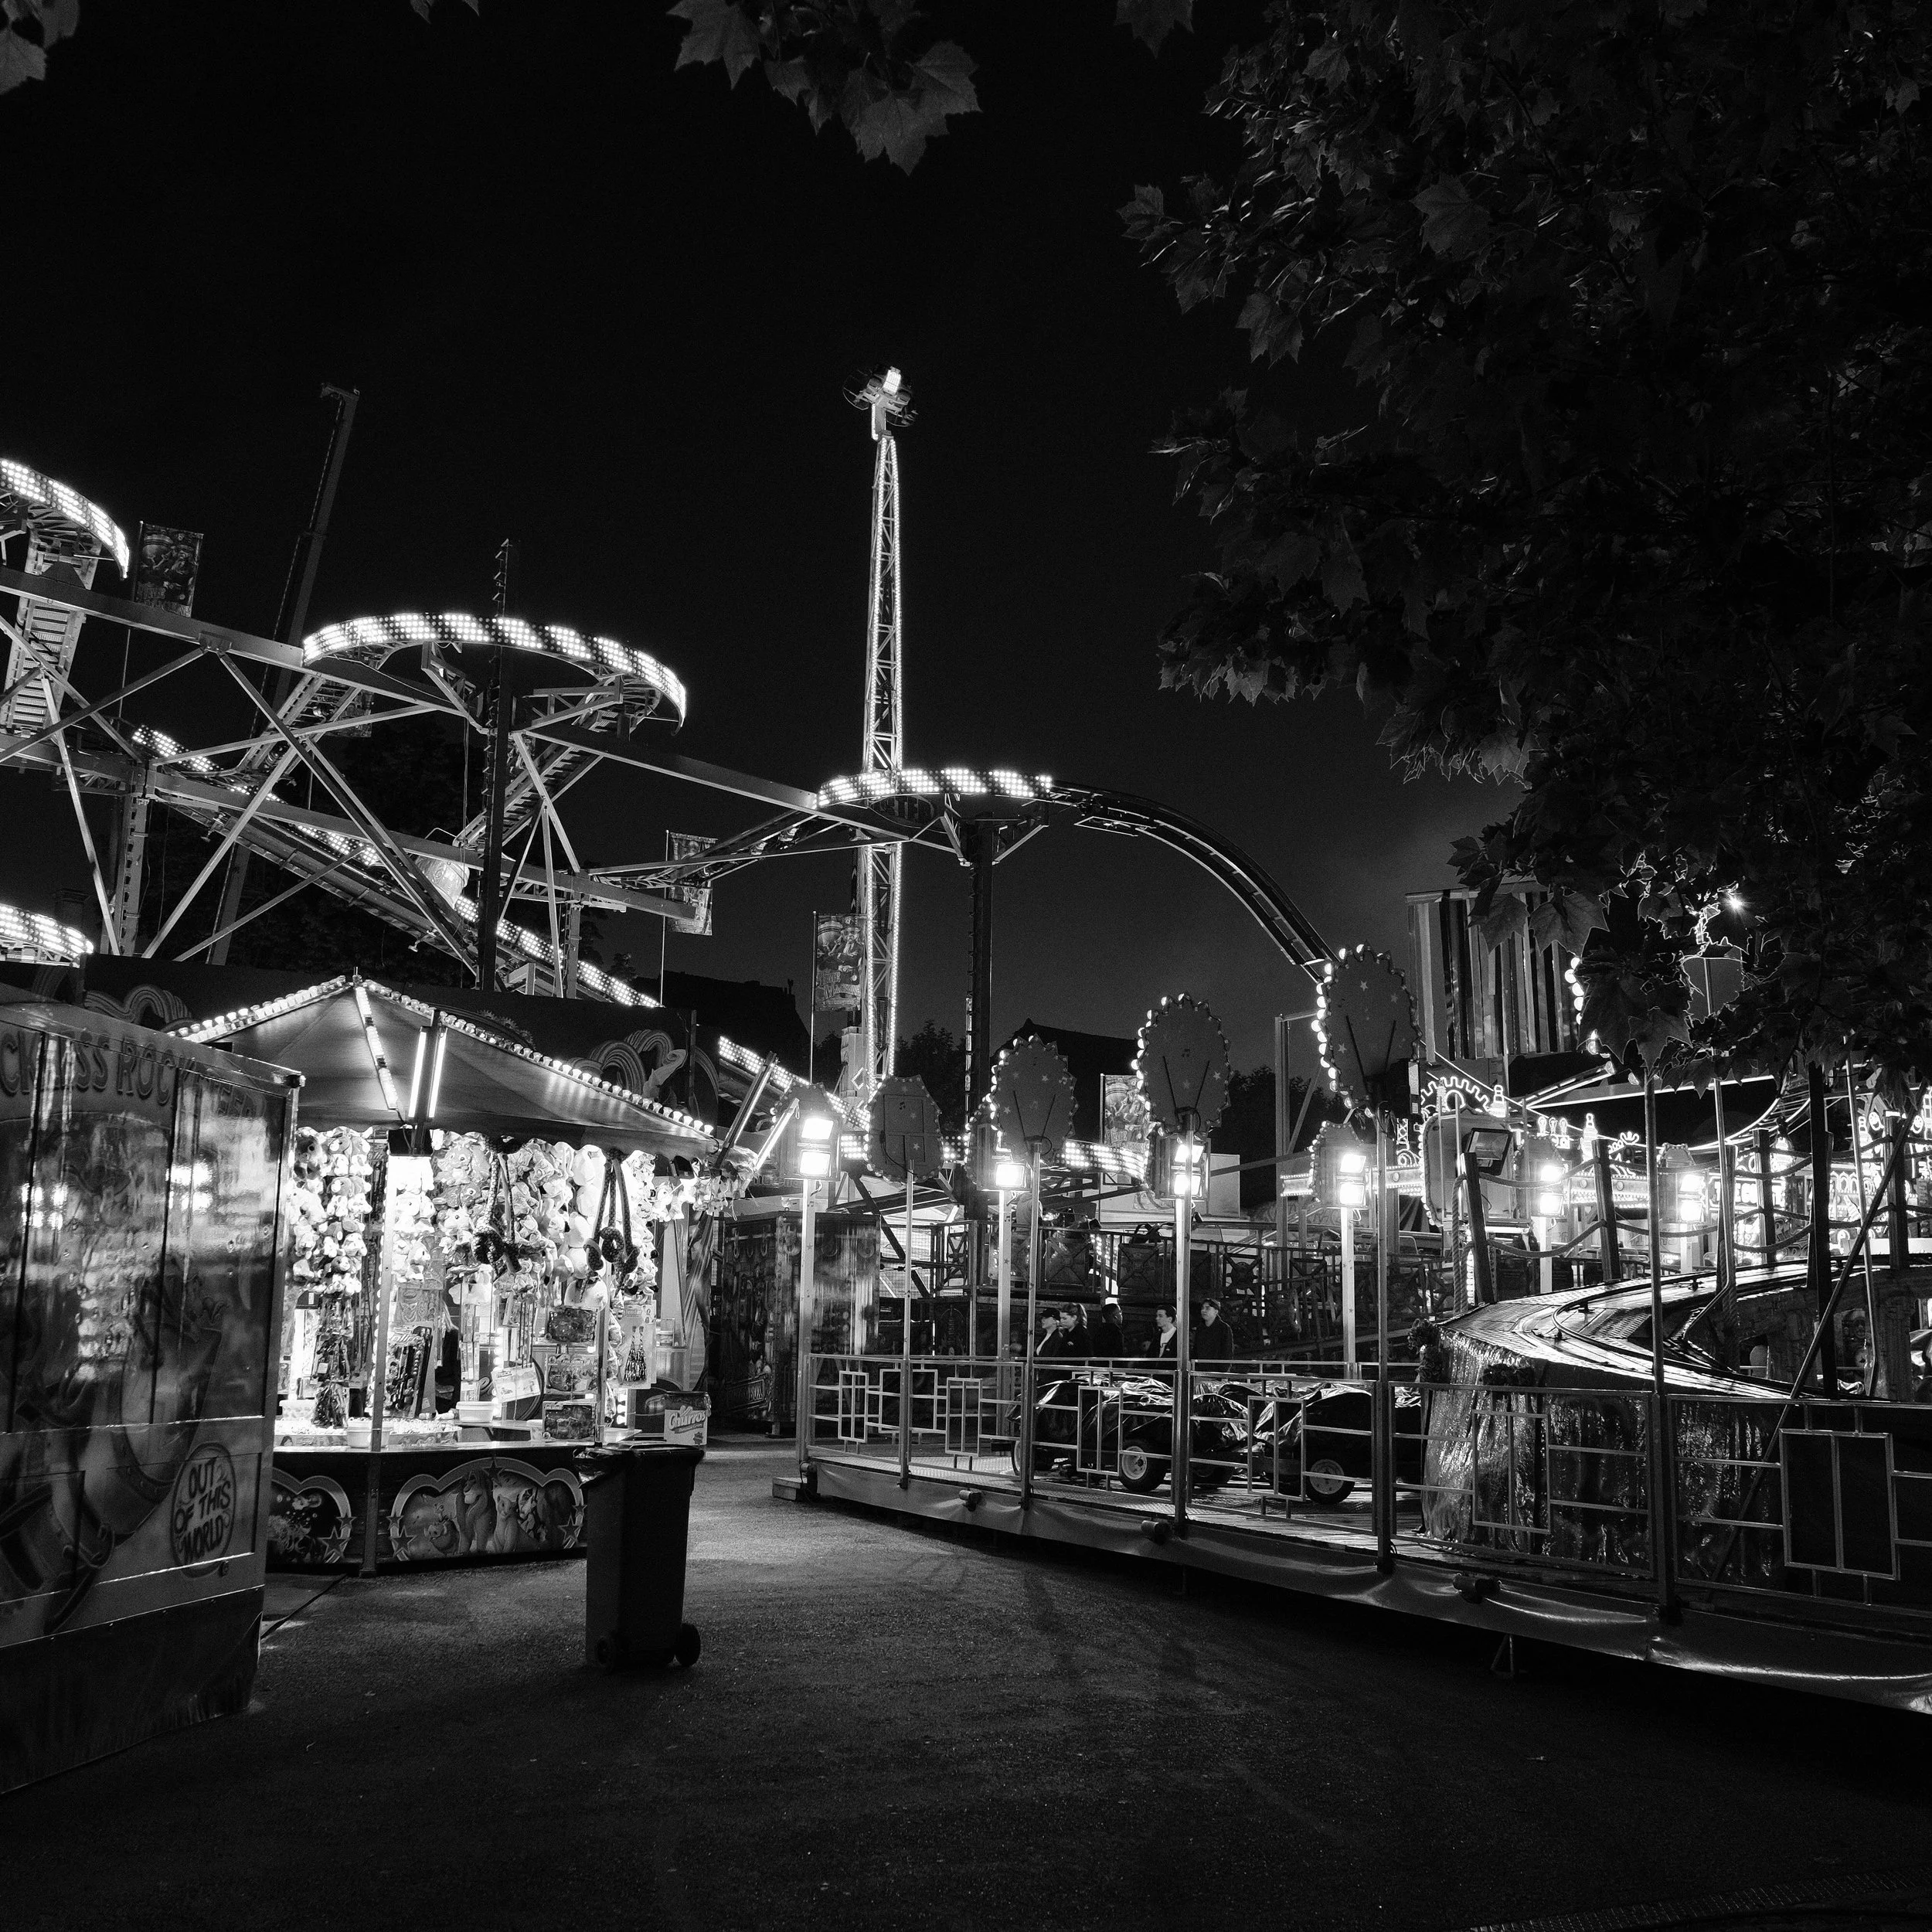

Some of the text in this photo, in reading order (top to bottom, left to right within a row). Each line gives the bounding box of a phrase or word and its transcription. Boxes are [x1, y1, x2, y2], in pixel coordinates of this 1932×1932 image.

[669, 1410, 706, 1430] Churros
[189, 1457, 216, 1498] OUT
[175, 1481, 230, 1535] OF THIS
[183, 1515, 223, 1563] WORLD
